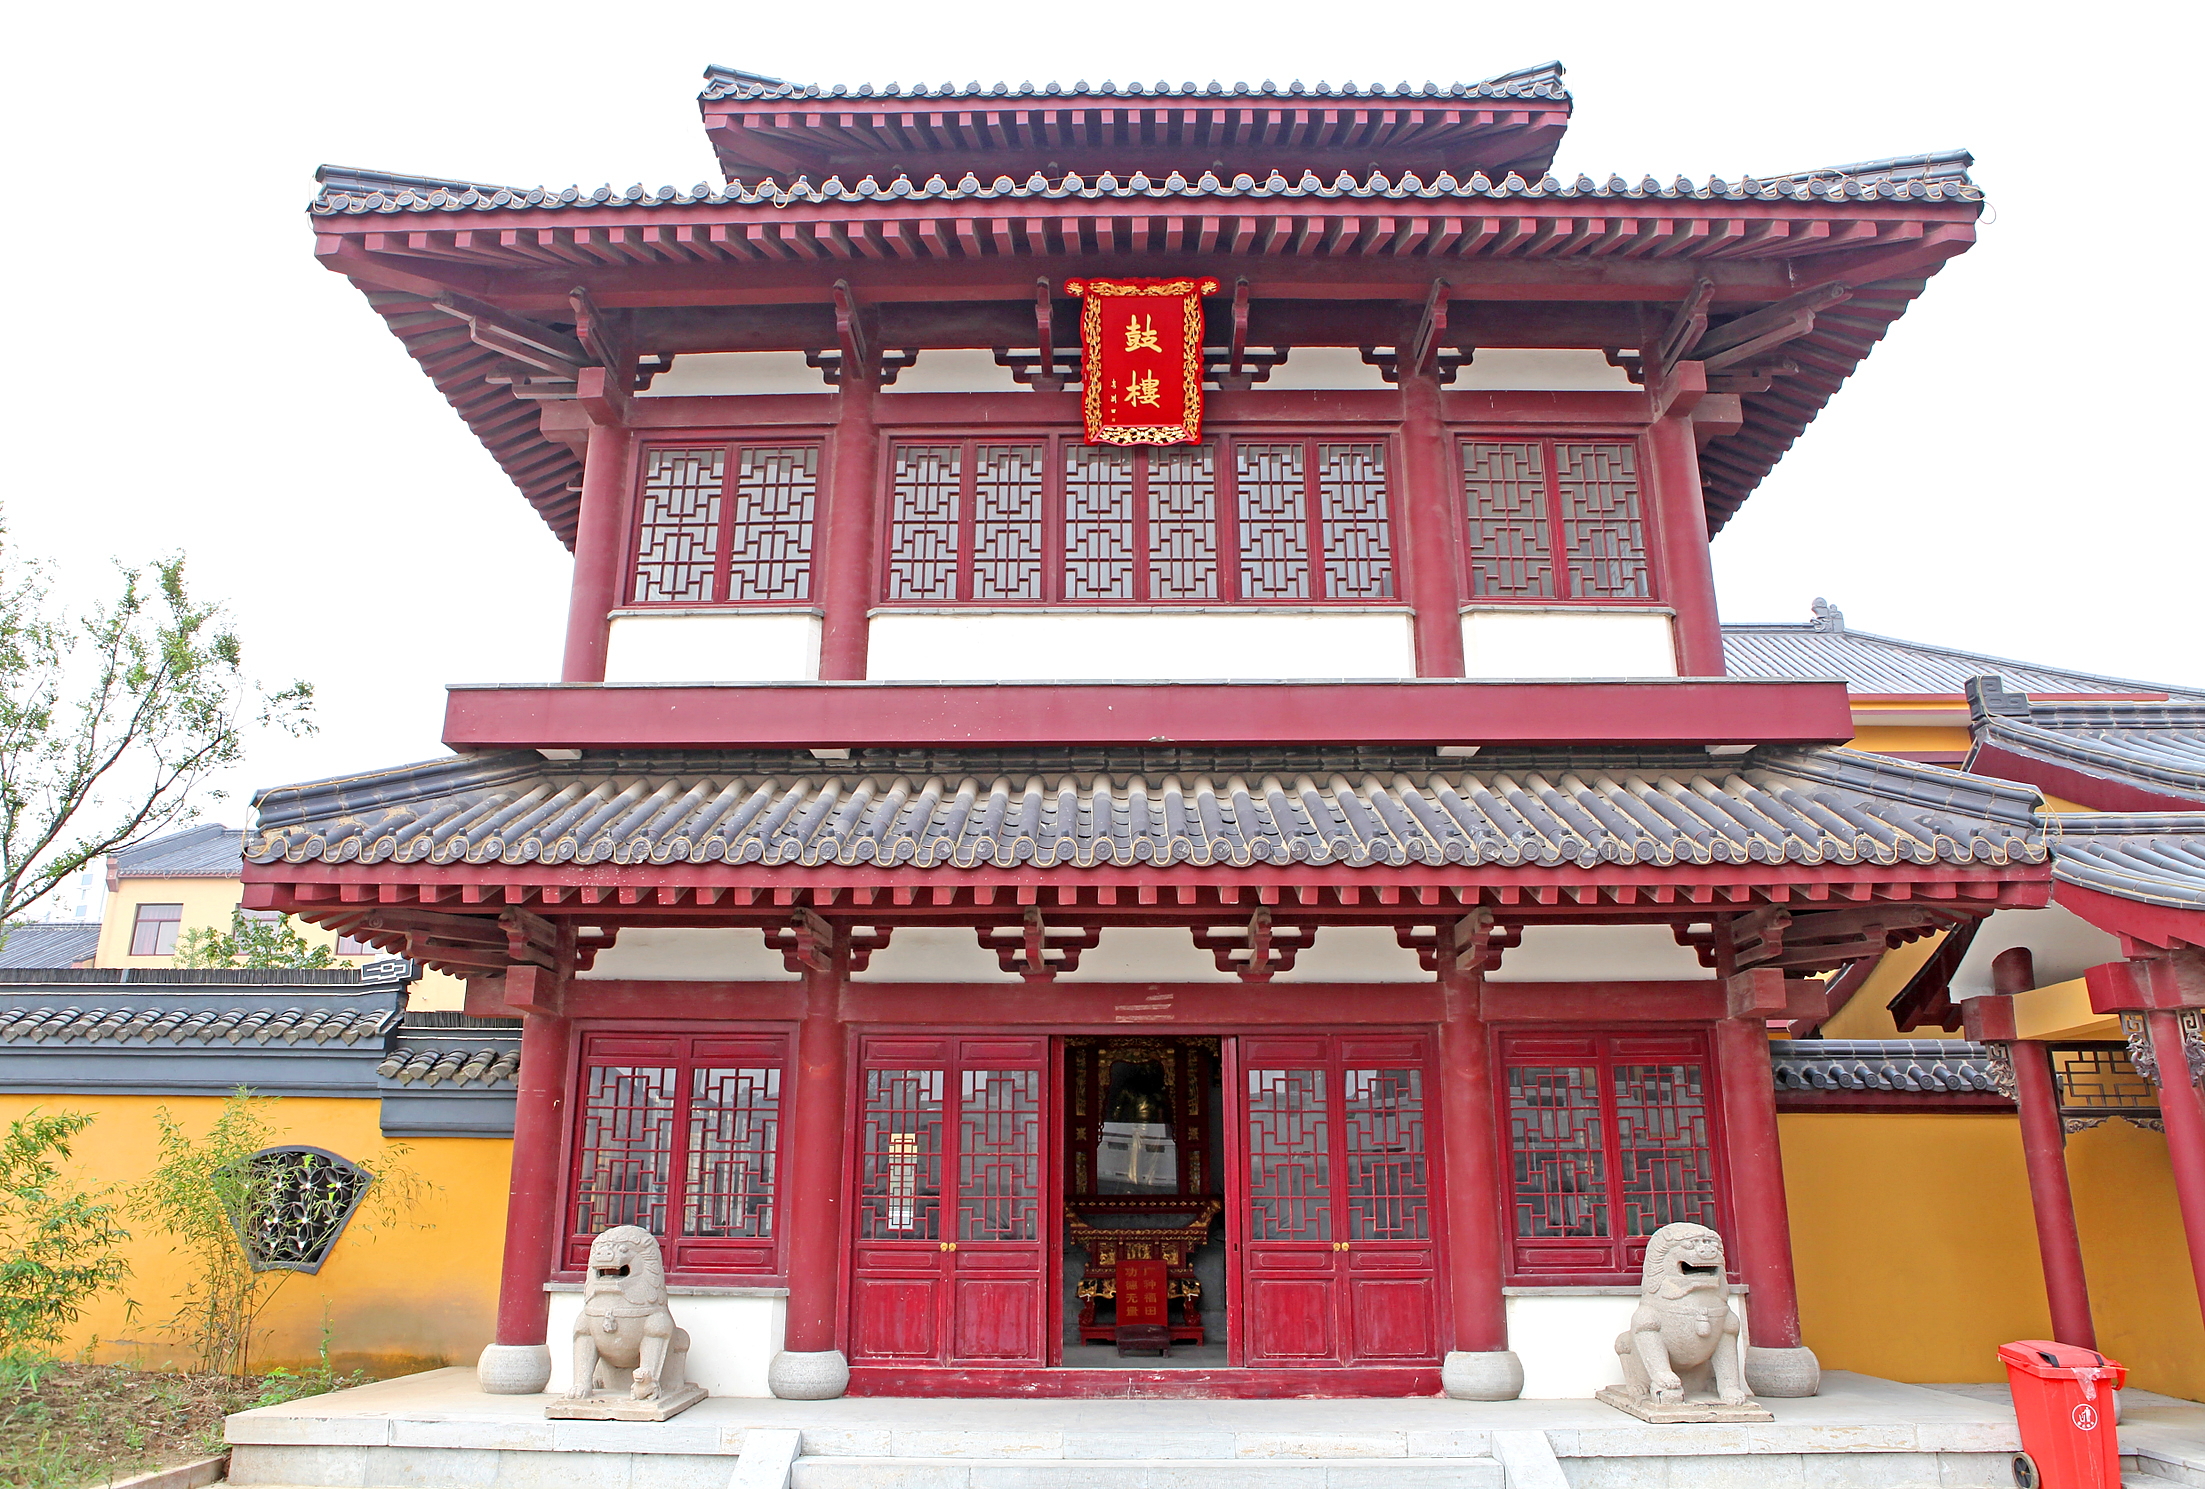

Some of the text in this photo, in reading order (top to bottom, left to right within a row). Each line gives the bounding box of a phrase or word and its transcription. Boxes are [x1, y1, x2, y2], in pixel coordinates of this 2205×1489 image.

[1124, 313, 1162, 408] 鼓樓
[1125, 1267, 1138, 1316] 功德无量
